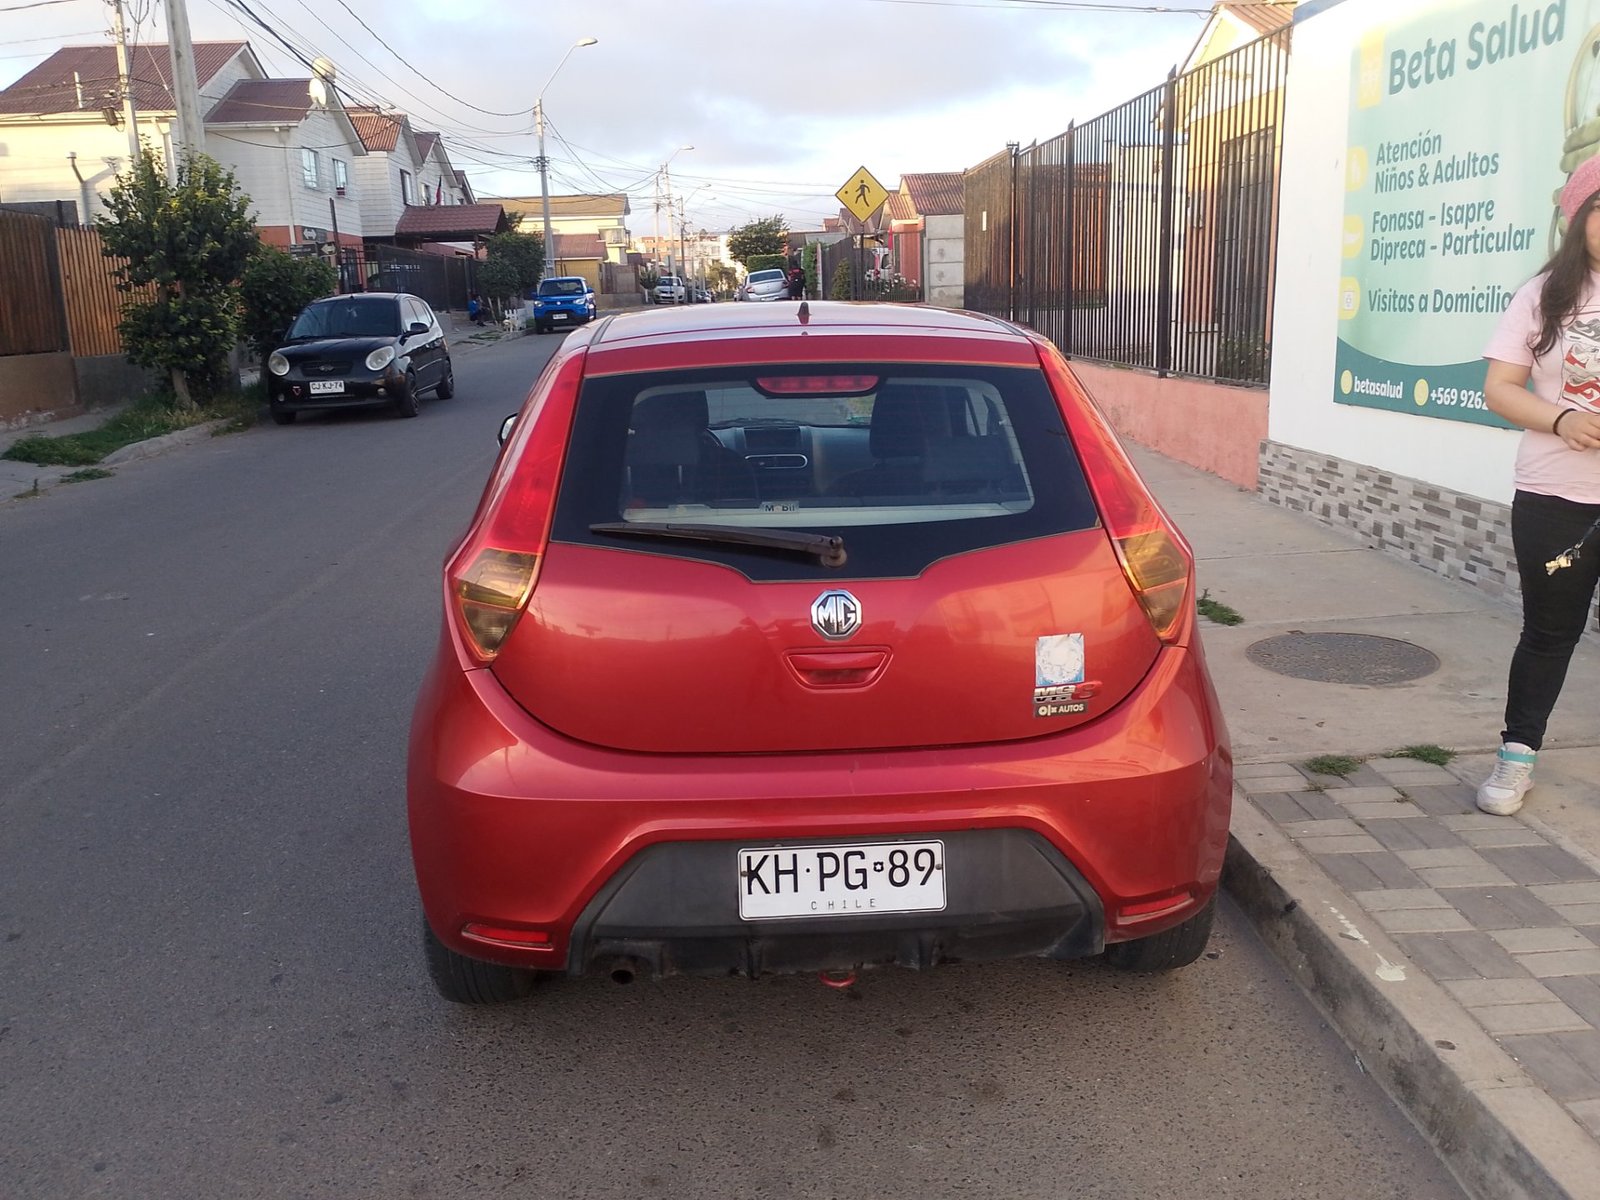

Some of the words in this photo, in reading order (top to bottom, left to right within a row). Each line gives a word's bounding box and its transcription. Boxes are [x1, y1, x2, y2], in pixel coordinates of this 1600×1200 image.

[1389, 38, 1456, 95] Beta
[1466, 0, 1567, 71] Salud
[1376, 130, 1442, 166] Atención
[1374, 166, 1414, 194] Niños
[1418, 163, 1429, 187] &
[1432, 152, 1500, 184] Adultos
[1372, 209, 1424, 233] Fonasa
[1441, 199, 1495, 230] Isapre
[1370, 237, 1426, 265] Dipreca
[1442, 223, 1535, 256] Particular
[1368, 289, 1415, 313] Visitas
[1418, 296, 1429, 313] a
[1432, 285, 1513, 313] Domicilio
[1354, 376, 1403, 399] betasalud
[1430, 387, 1458, 406] +569
[816, 594, 858, 634] MG
[1058, 704, 1085, 713] AUTOS
[811, 898, 877, 911] CHILE
